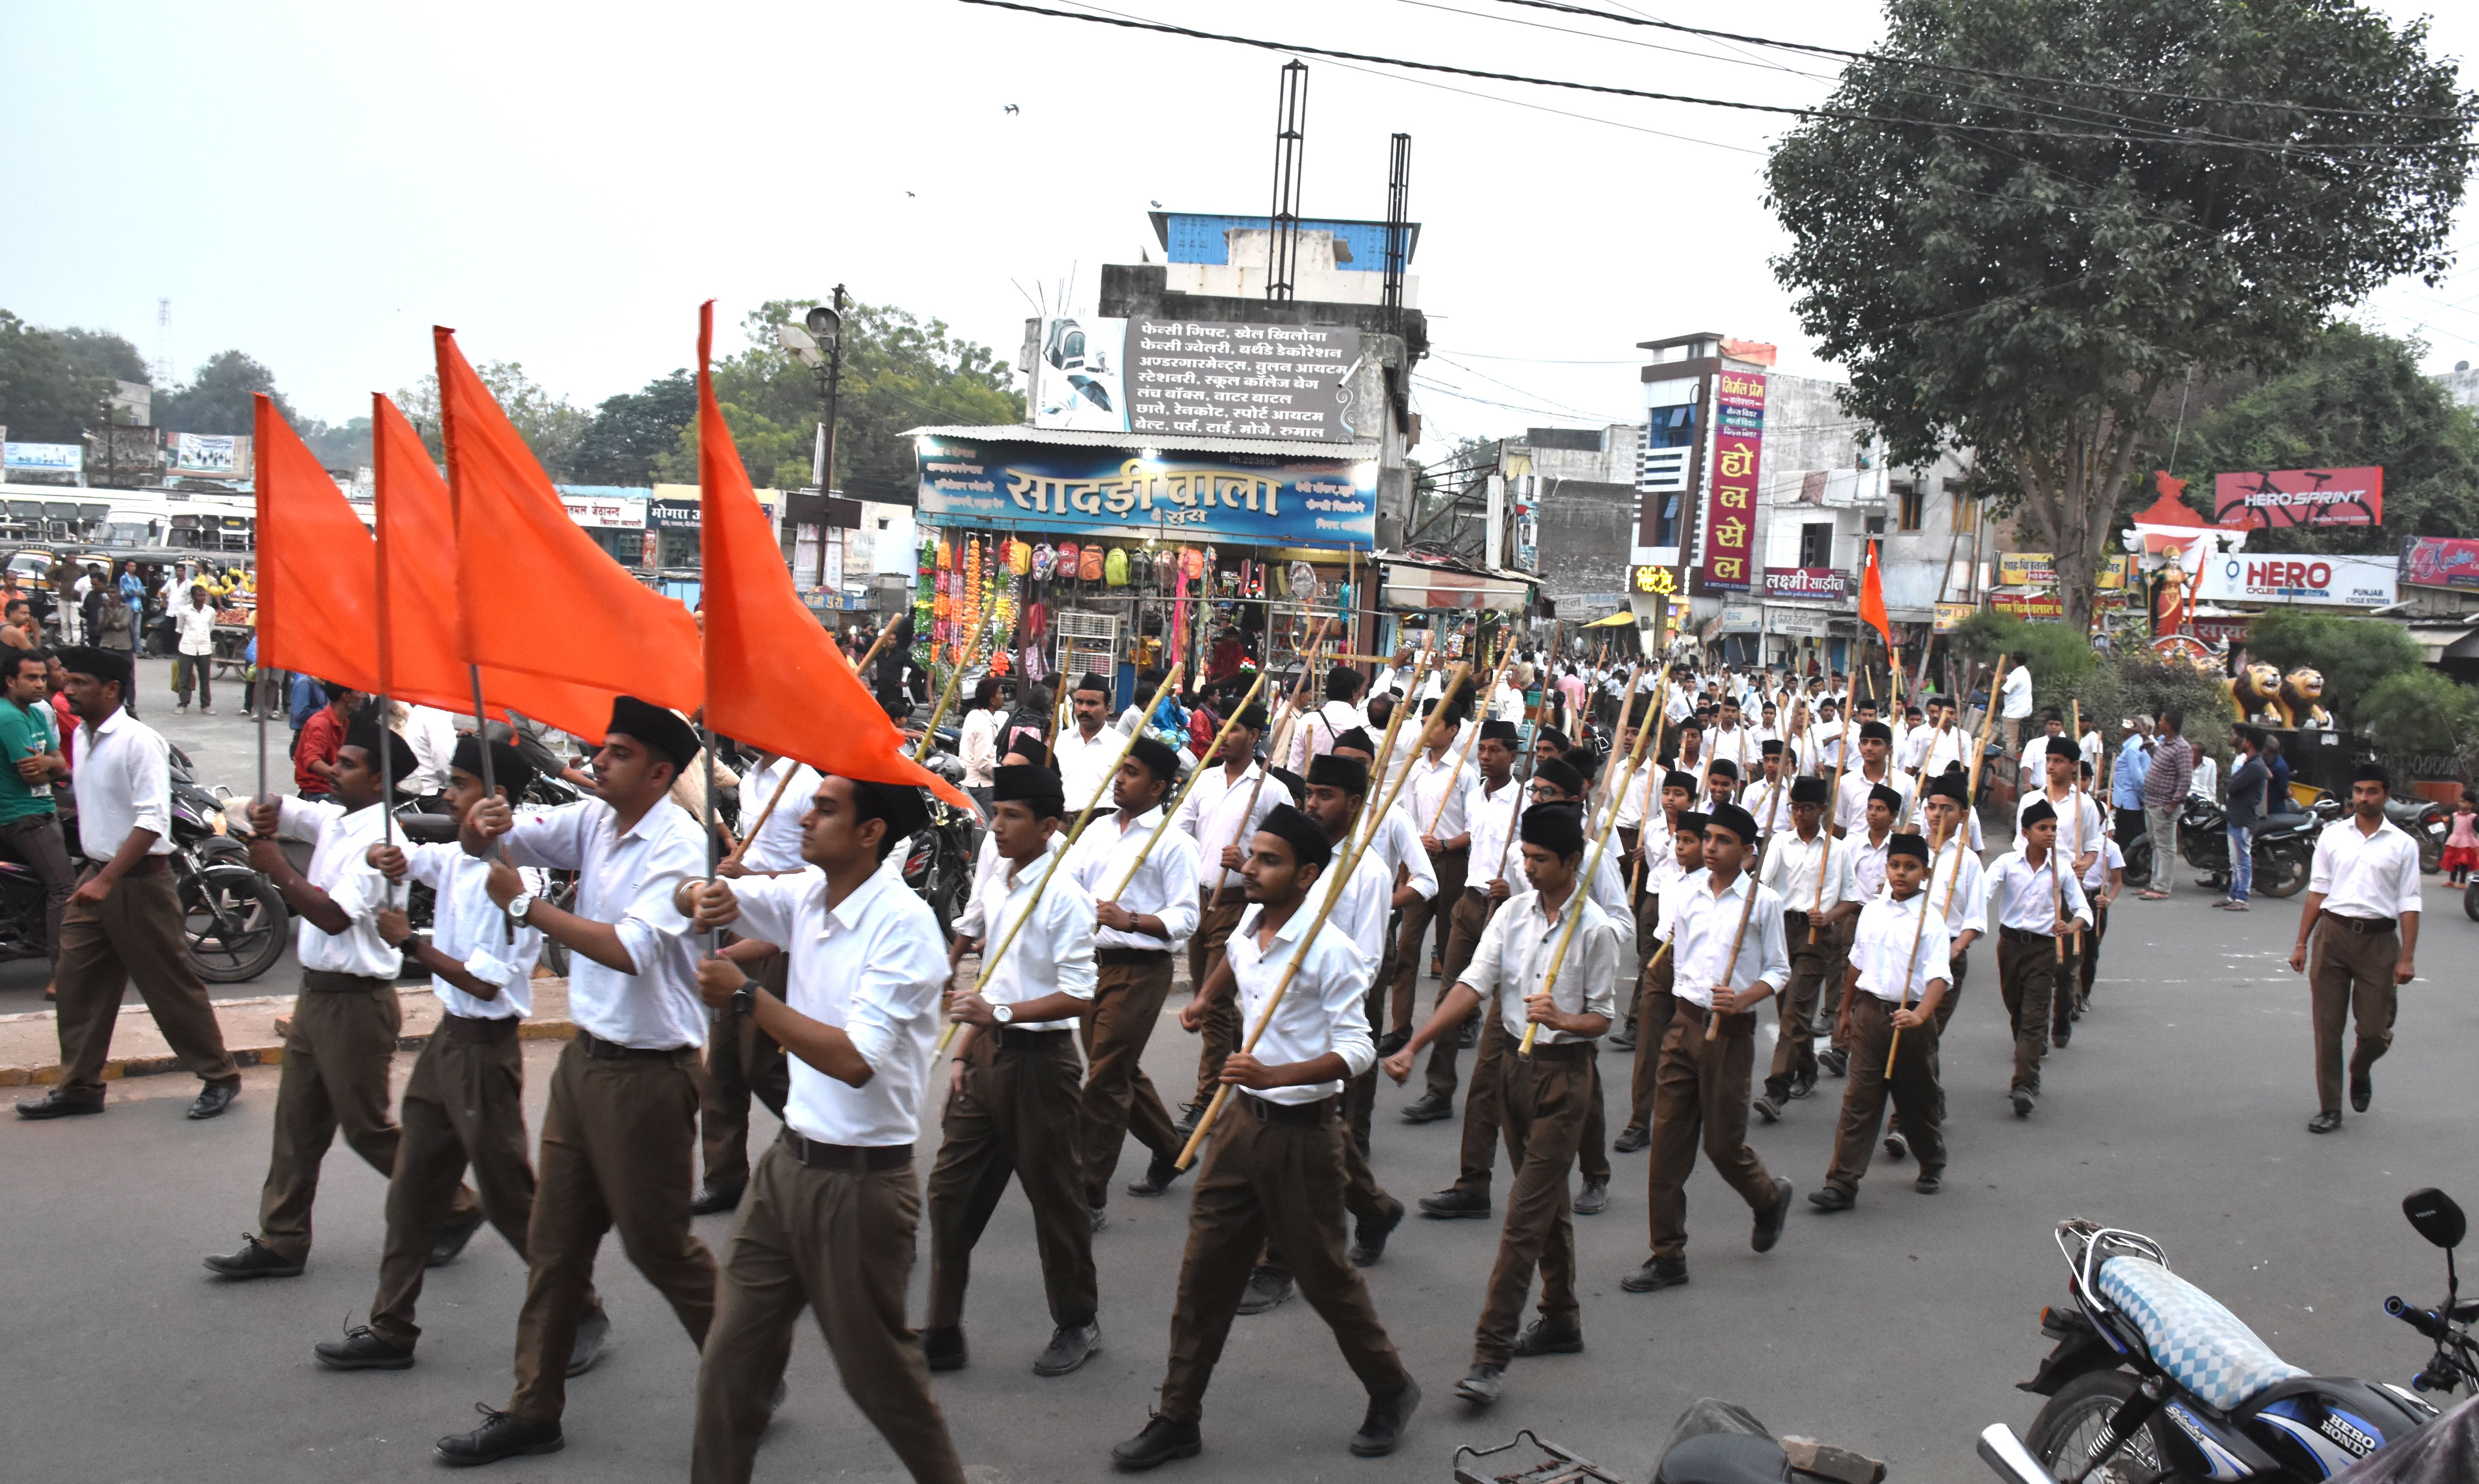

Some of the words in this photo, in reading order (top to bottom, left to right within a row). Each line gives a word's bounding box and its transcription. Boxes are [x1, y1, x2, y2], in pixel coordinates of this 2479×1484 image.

[1141, 321, 1183, 336] फेन्सी
[1234, 326, 1264, 339] खेल
[1267, 327, 1328, 342] खिलोना
[1140, 337, 1182, 351] फेन्सी
[1184, 339, 1235, 355] ज्वेलरी,
[1276, 343, 1342, 358] डेकोरेशन
[1255, 362, 1292, 375] वुलन
[1295, 363, 1347, 375] आयटम
[1138, 369, 1201, 385] स्टेशनरी,
[1204, 375, 1241, 389] स्कूल
[1243, 374, 1290, 388] कॉलेज
[1293, 375, 1319, 389] बेग
[1722, 375, 1747, 395] निर्मल
[1748, 379, 1764, 398] प्रेम
[1137, 385, 1162, 398] लंच
[1164, 387, 1209, 401] बॉक्स,
[1214, 392, 1249, 402] वाटर
[1252, 393, 1293, 404] बाटल
[1136, 401, 1170, 415] छाते,
[1174, 402, 1229, 418] रेनकोट,
[1233, 405, 1269, 419] स्पोर्ट
[1271, 410, 1325, 421] आयटम
[1134, 416, 1169, 431] बेल्ट,
[1173, 419, 1202, 433] पर्स,
[1206, 420, 1236, 434] टाई,
[1240, 421, 1276, 436] मोजे,
[1279, 427, 1325, 437] रुमाल
[1230, 455, 1276, 466] Ph.223856
[1006, 458, 1157, 519] सादड़ी
[1165, 470, 1283, 516] वाला
[2244, 493, 2293, 507] HERO
[2292, 490, 2366, 505] SPRINT
[651, 504, 689, 519] मोगरा
[692, 509, 703, 519] अ
[1166, 506, 1208, 525] संस
[2004, 560, 2018, 570] शाह
[2246, 561, 2331, 589] HERO
[1766, 569, 1809, 590] लक्ष्मी
[2246, 587, 2276, 595] CYCLES
[2353, 588, 2384, 597] PUNJAB
[2330, 1413, 2376, 1449] HERO
